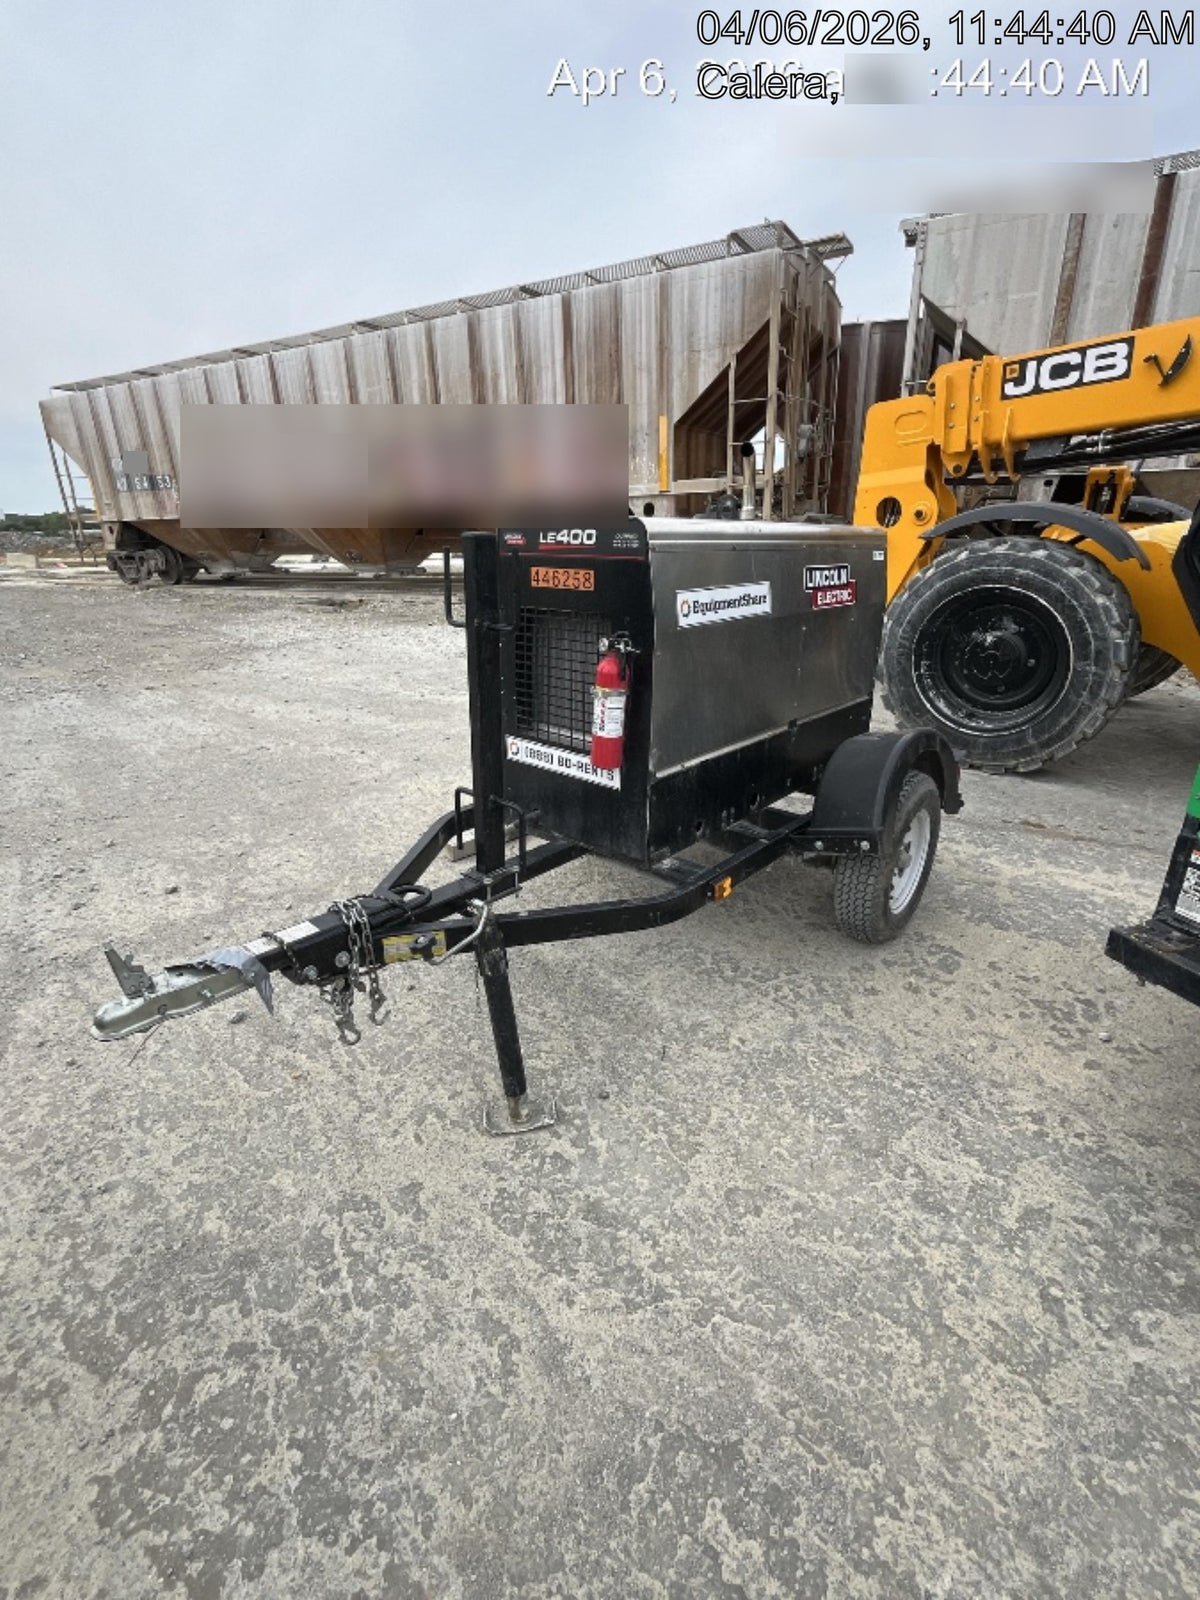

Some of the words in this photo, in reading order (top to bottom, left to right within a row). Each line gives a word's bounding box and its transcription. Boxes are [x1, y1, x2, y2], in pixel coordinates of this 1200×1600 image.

[1003, 342, 1130, 397] JCB
[539, 528, 598, 545] LE400
[532, 567, 594, 590] 446258
[805, 568, 848, 589] LINCOLN
[692, 592, 768, 616] EquipmentShare
[817, 587, 853, 606] ELECTRIC
